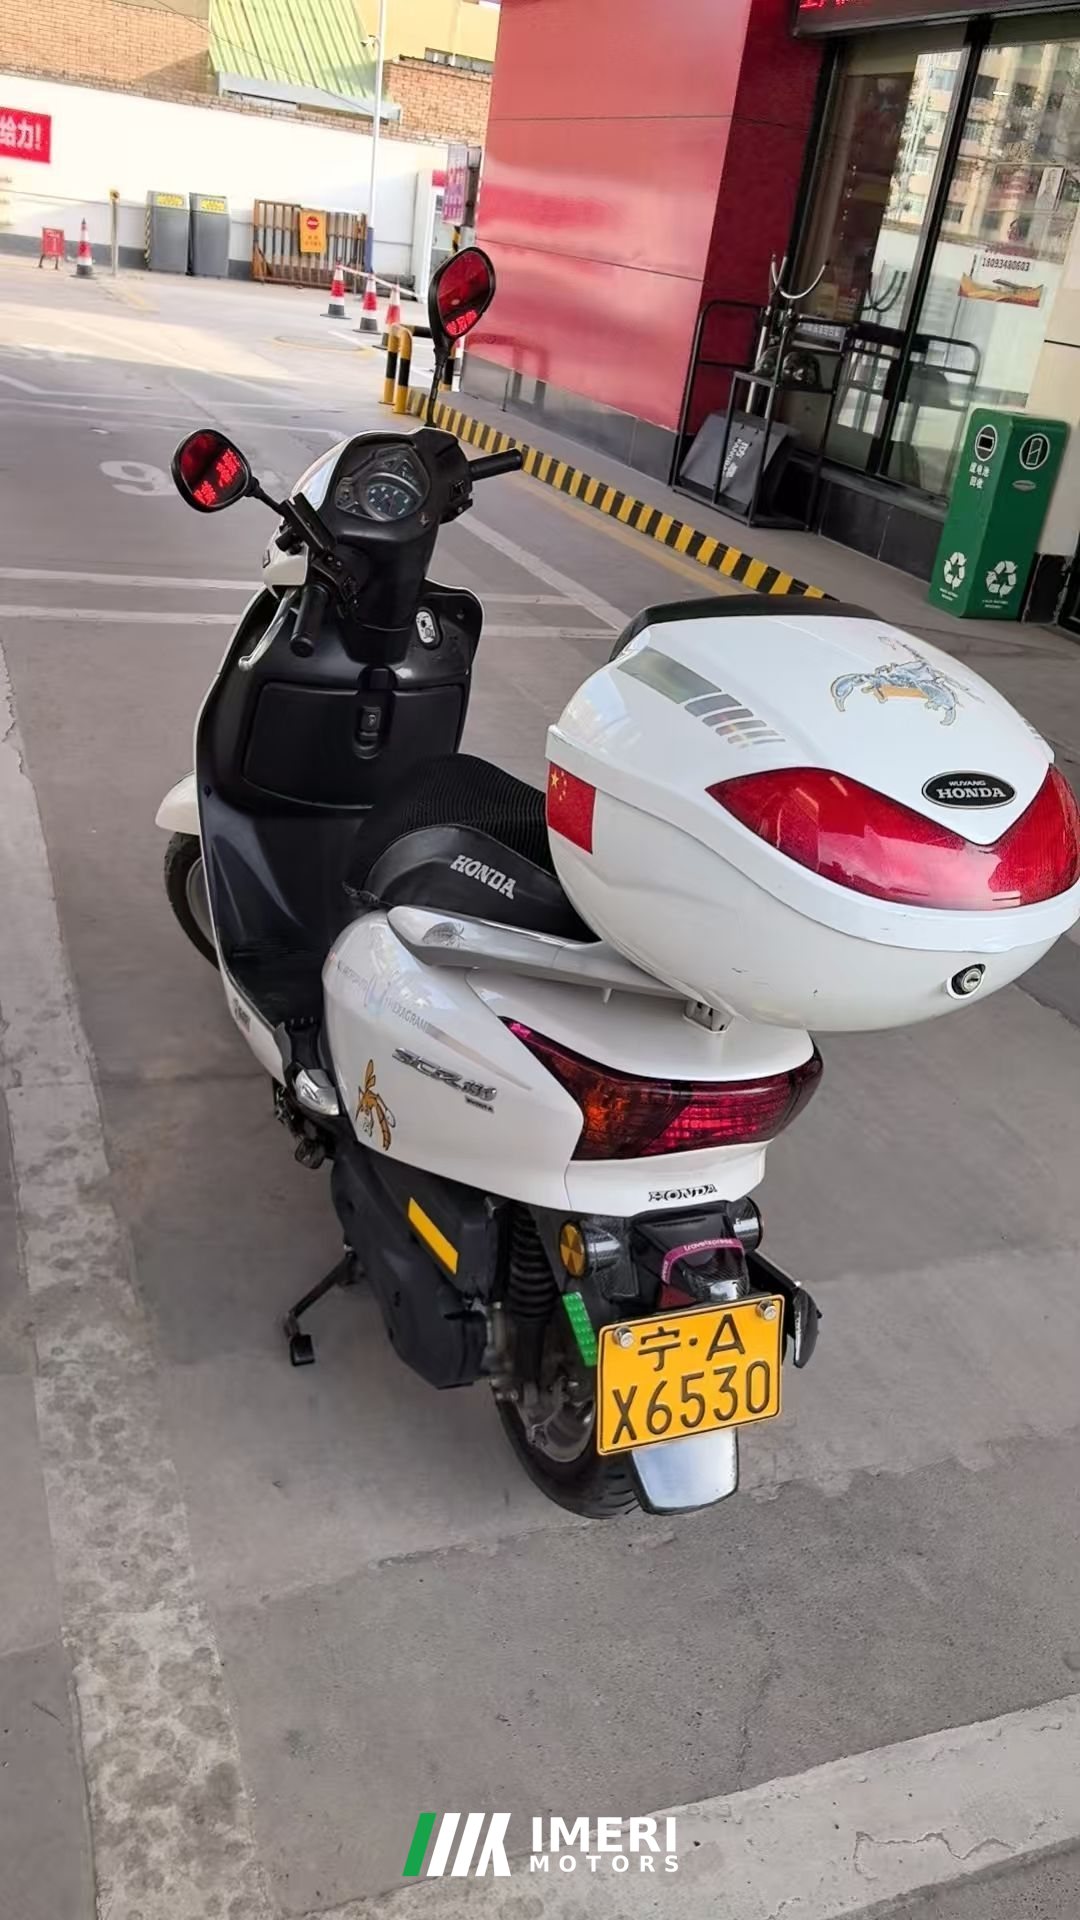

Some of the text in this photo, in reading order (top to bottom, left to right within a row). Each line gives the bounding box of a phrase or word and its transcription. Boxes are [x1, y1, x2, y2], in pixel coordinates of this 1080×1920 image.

[936, 787, 1007, 799] HONDA
[449, 854, 517, 900] HONDA
[647, 1184, 718, 1202] HONDA
[611, 1360, 771, 1445] X6530
